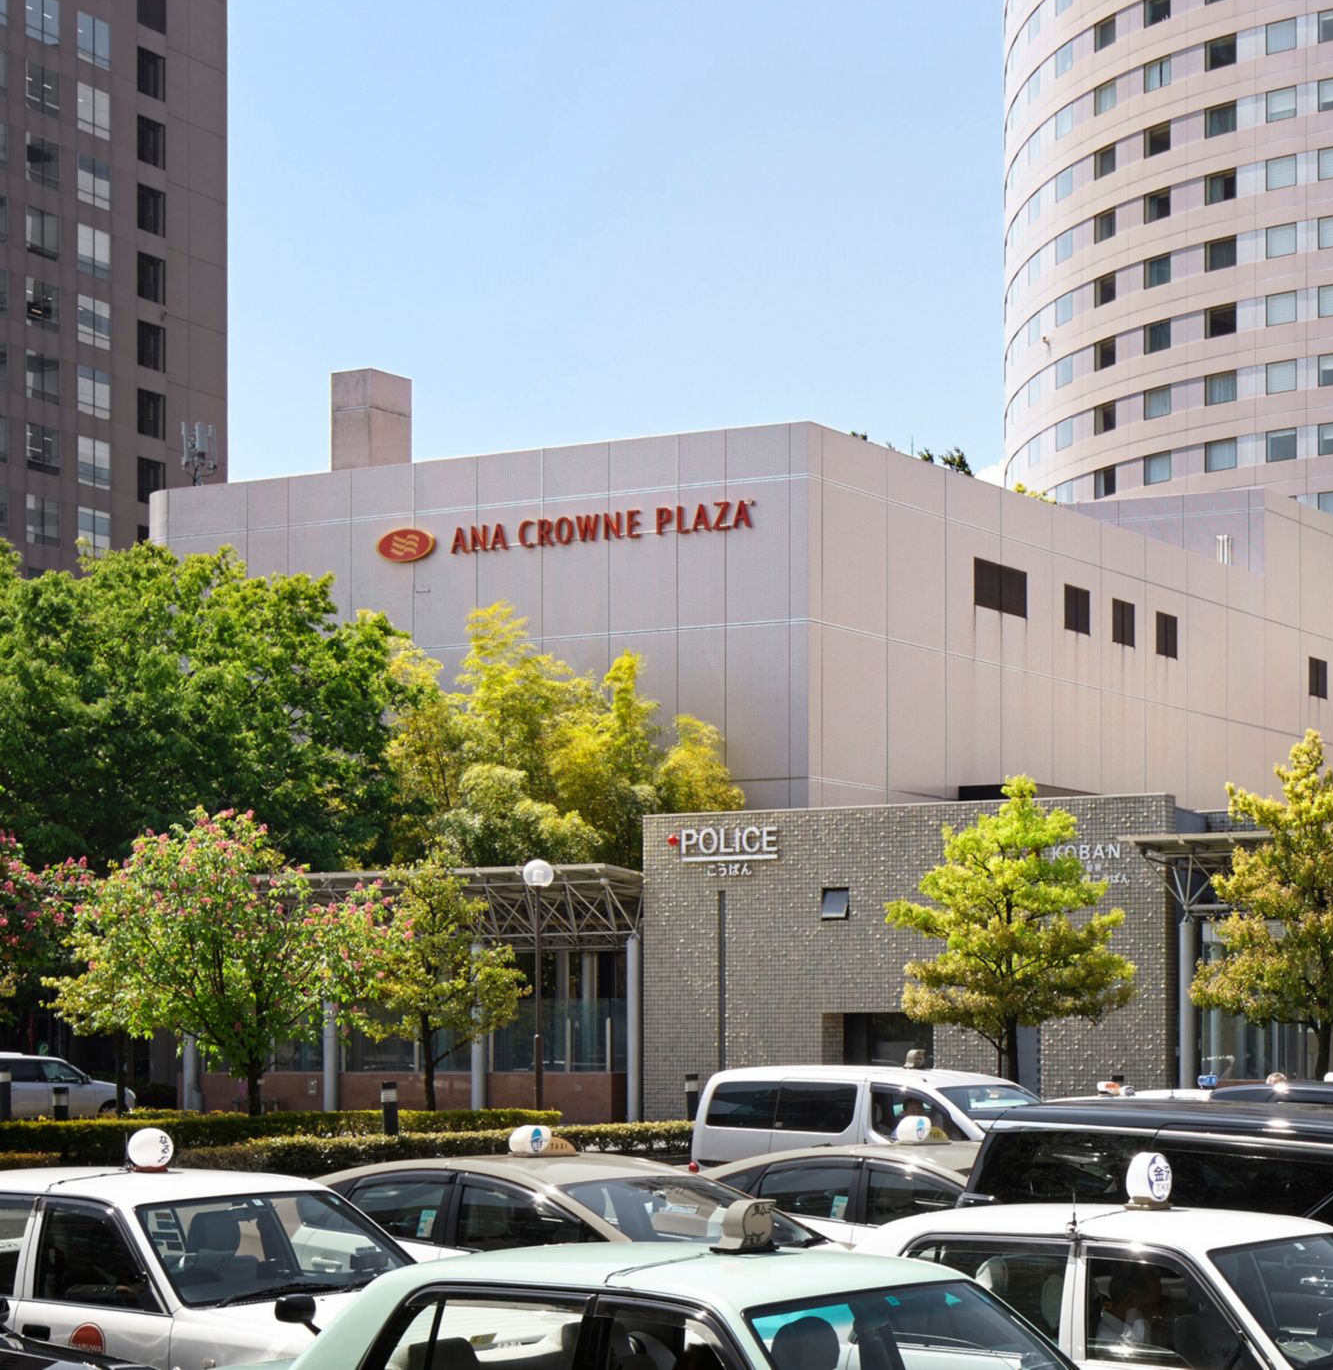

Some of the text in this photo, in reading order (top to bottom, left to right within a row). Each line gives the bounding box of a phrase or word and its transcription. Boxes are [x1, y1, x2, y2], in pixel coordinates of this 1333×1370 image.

[450, 500, 753, 555] ANA CROWNE PLAZA
[681, 826, 778, 854] POLICE
[1052, 843, 1120, 860] KOBAN
[707, 862, 753, 877] こうばん
